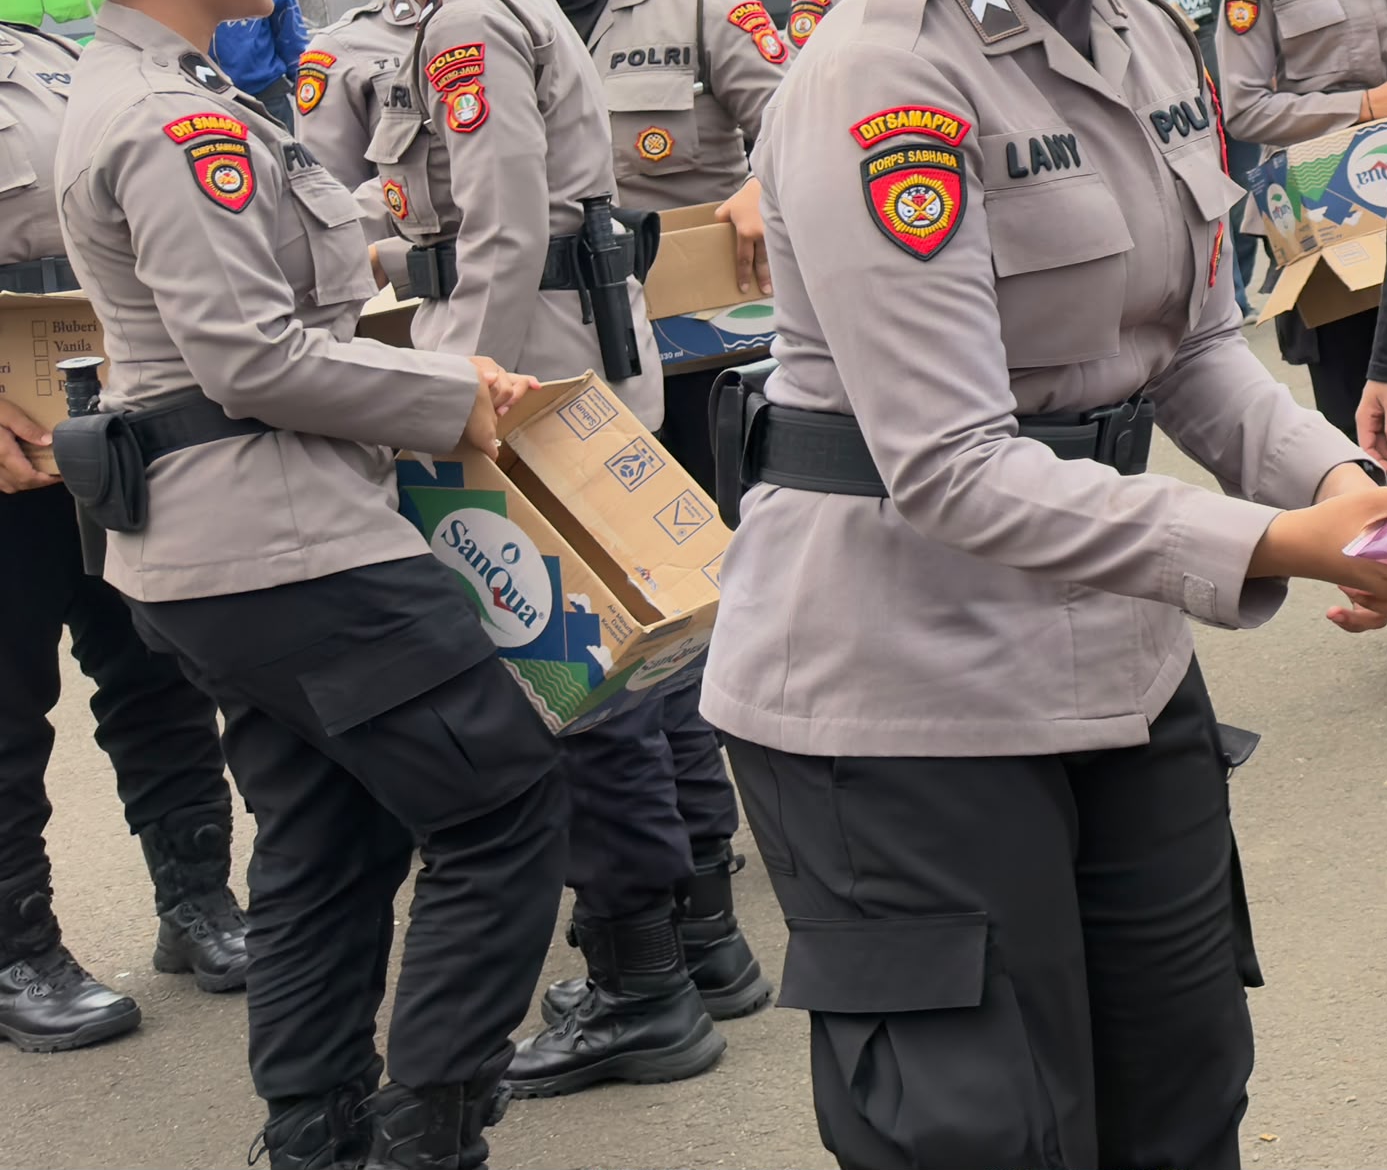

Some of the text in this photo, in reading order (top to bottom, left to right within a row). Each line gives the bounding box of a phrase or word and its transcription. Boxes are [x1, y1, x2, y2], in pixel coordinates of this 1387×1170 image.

[731, 3, 762, 21] POLDA
[429, 46, 480, 74] POLDA
[610, 46, 690, 69] POLRI
[868, 149, 957, 175] KORPS SABHARA
[1005, 133, 1081, 179] LANY
[52, 320, 97, 333] Bluberi
[54, 339, 92, 352] Vanila
[575, 403, 597, 427] Sabun
[441, 519, 538, 630] SanQua
